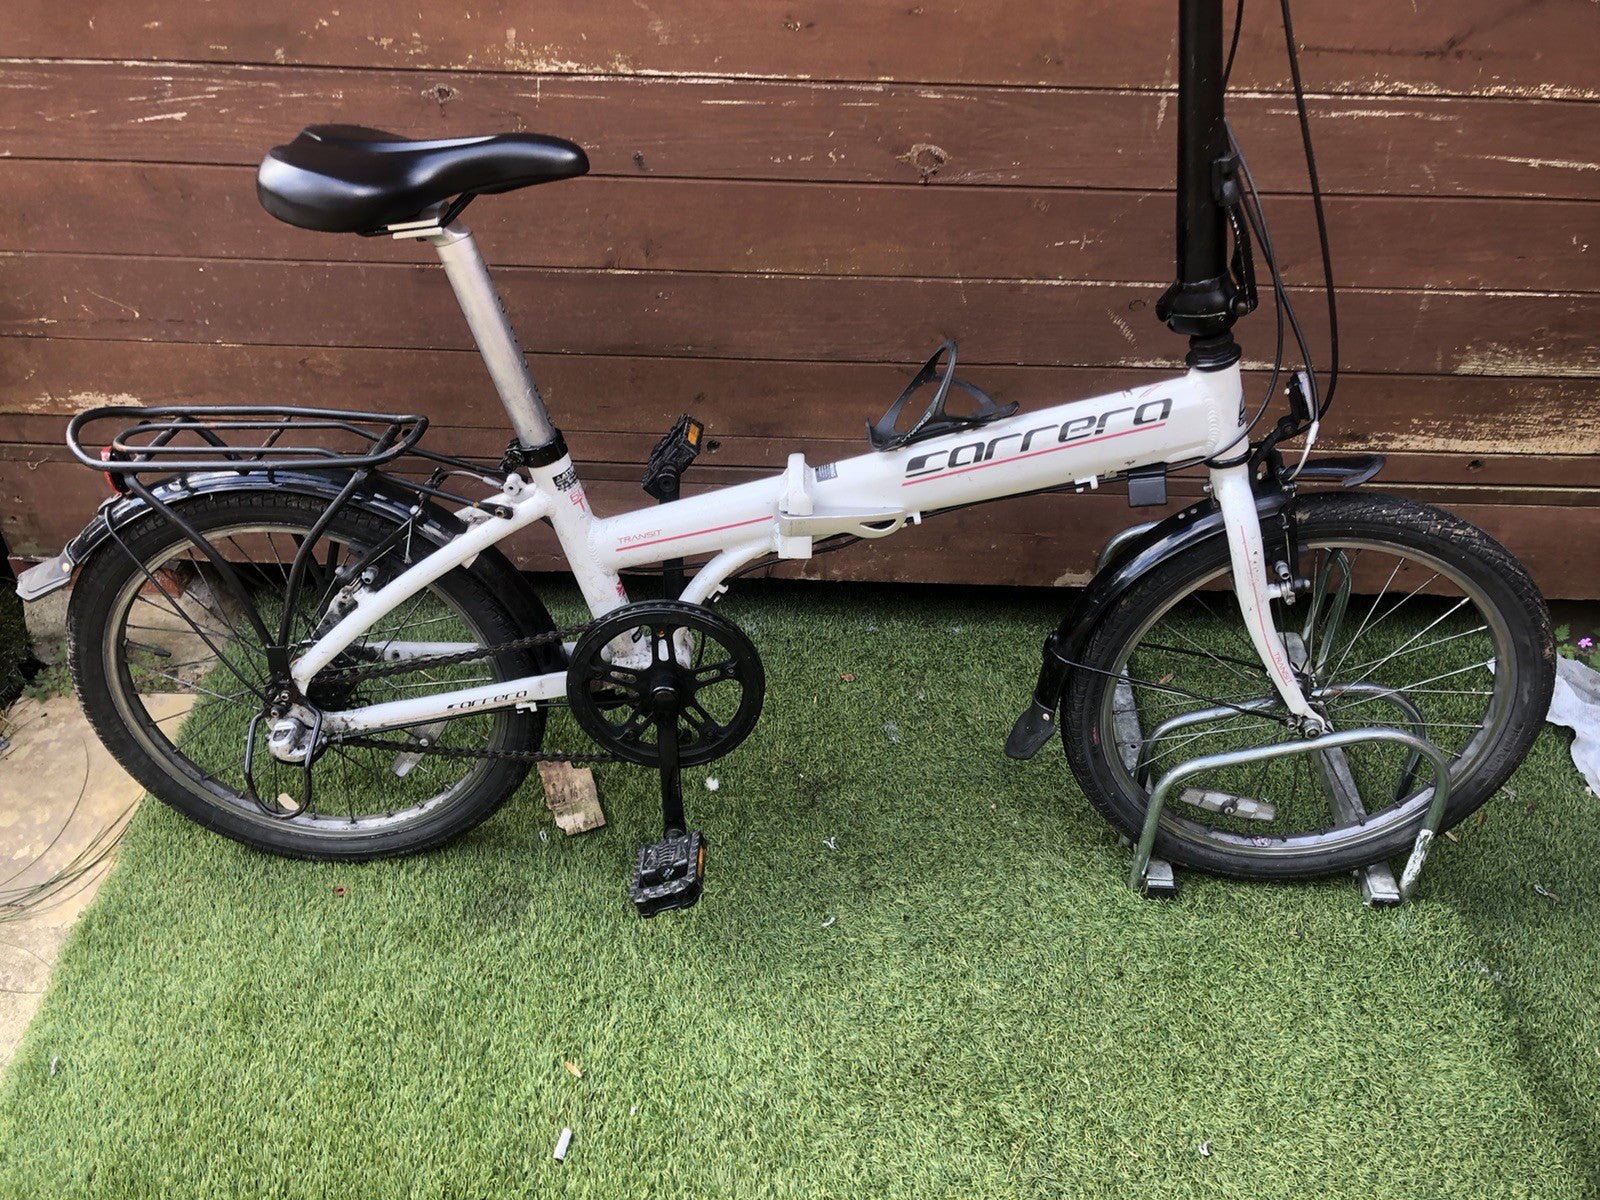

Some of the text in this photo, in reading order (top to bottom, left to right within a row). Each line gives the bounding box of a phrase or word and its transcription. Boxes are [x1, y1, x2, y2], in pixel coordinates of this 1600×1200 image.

[905, 398, 1173, 479] carrera
[617, 528, 662, 544] TRANSIT
[1274, 652, 1291, 683] TRANSIT
[447, 691, 527, 709] carrera
